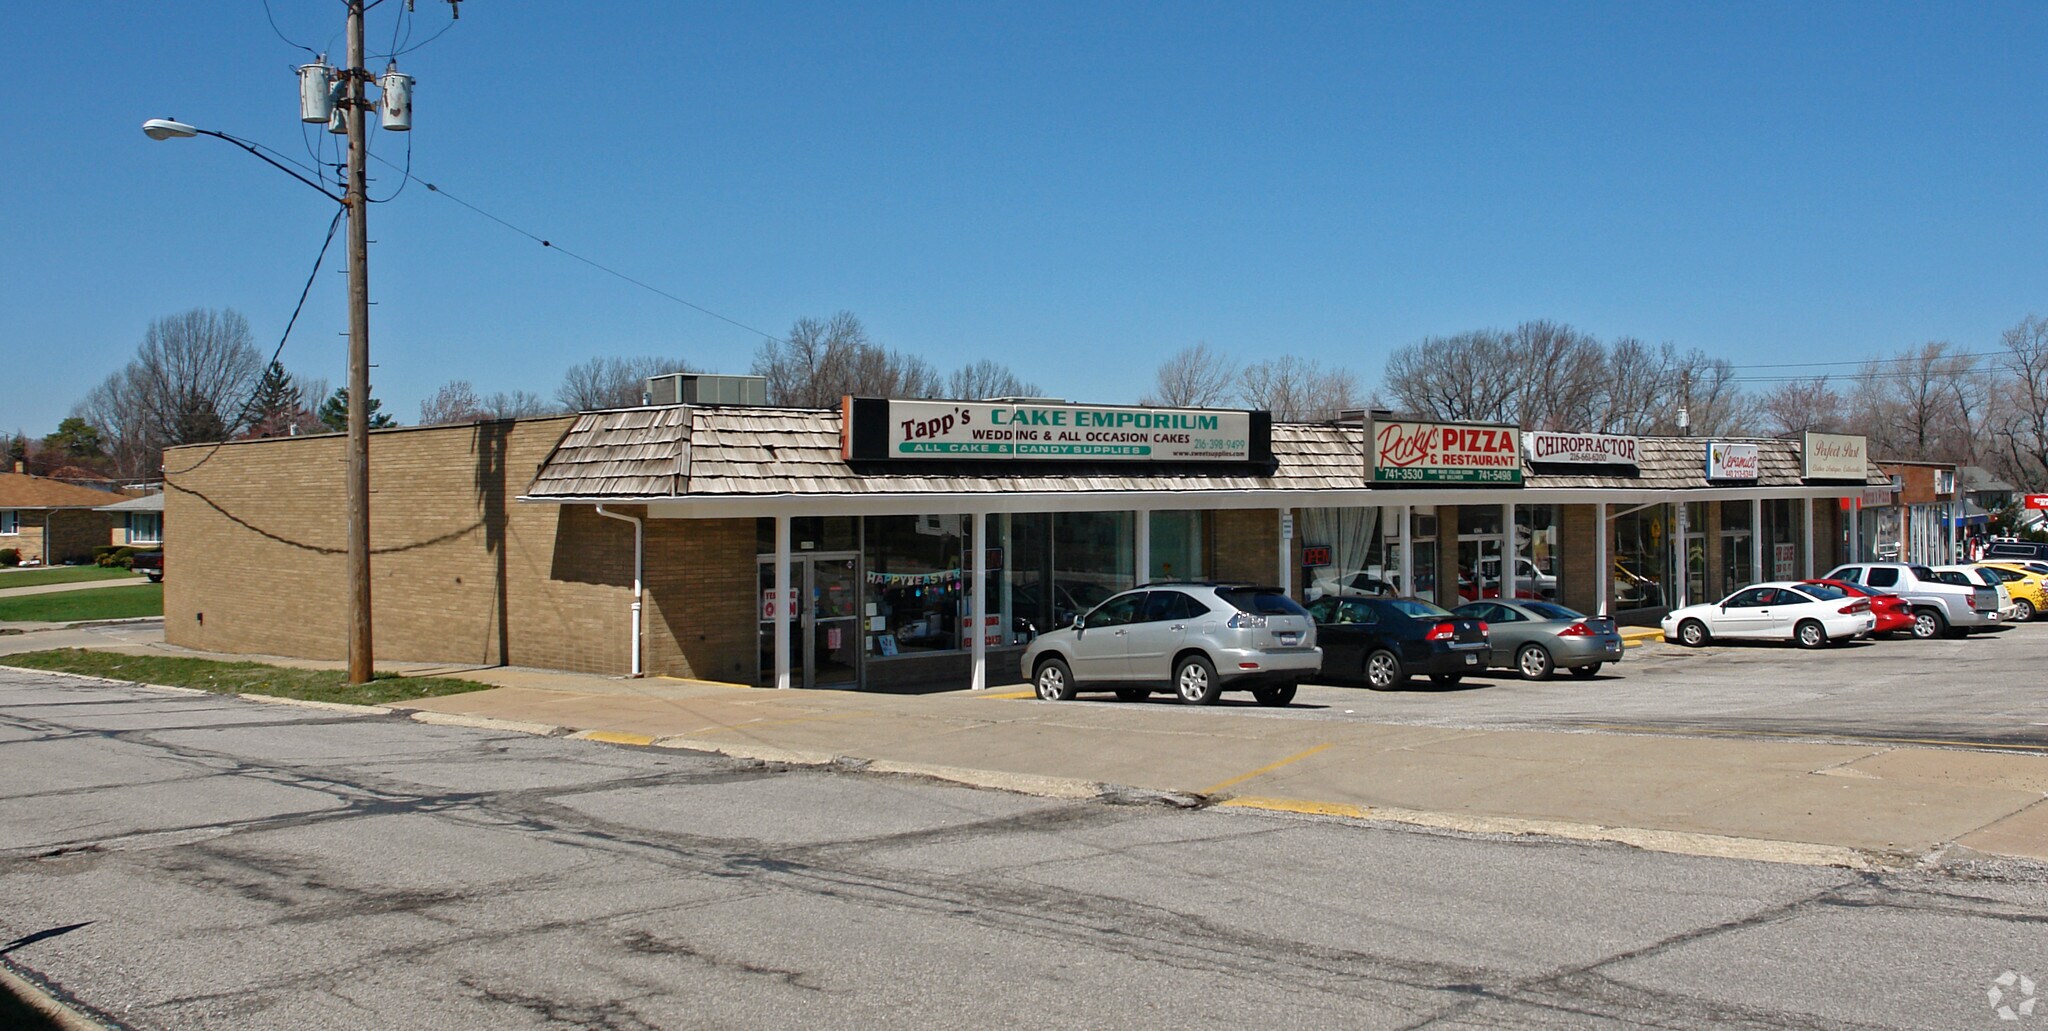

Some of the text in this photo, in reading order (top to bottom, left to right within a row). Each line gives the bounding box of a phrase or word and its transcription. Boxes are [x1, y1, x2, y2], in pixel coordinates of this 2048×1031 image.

[901, 407, 971, 441] Tapp's
[991, 409, 1218, 430] CAKE EMPORIUM
[972, 429, 1190, 444] WEDDING & ALL OCCASION CAKES
[1194, 439, 1245, 449] 216-398-9499
[1442, 428, 1515, 453] PIZZA
[913, 443, 1140, 454] ALL CAKE & CANDY SUPPLIES
[1377, 424, 1439, 471] Rocky's
[1536, 436, 1636, 461] CHIROPRACTOR
[1814, 439, 1841, 461] Perfect
[1430, 454, 1515, 466] & RESTAURANT
[1721, 445, 1757, 470] Ceramics
[1384, 468, 1424, 480] 741-3530
[1303, 548, 1329, 565] OPEN
[866, 569, 961, 586] HAPPY EASTER
